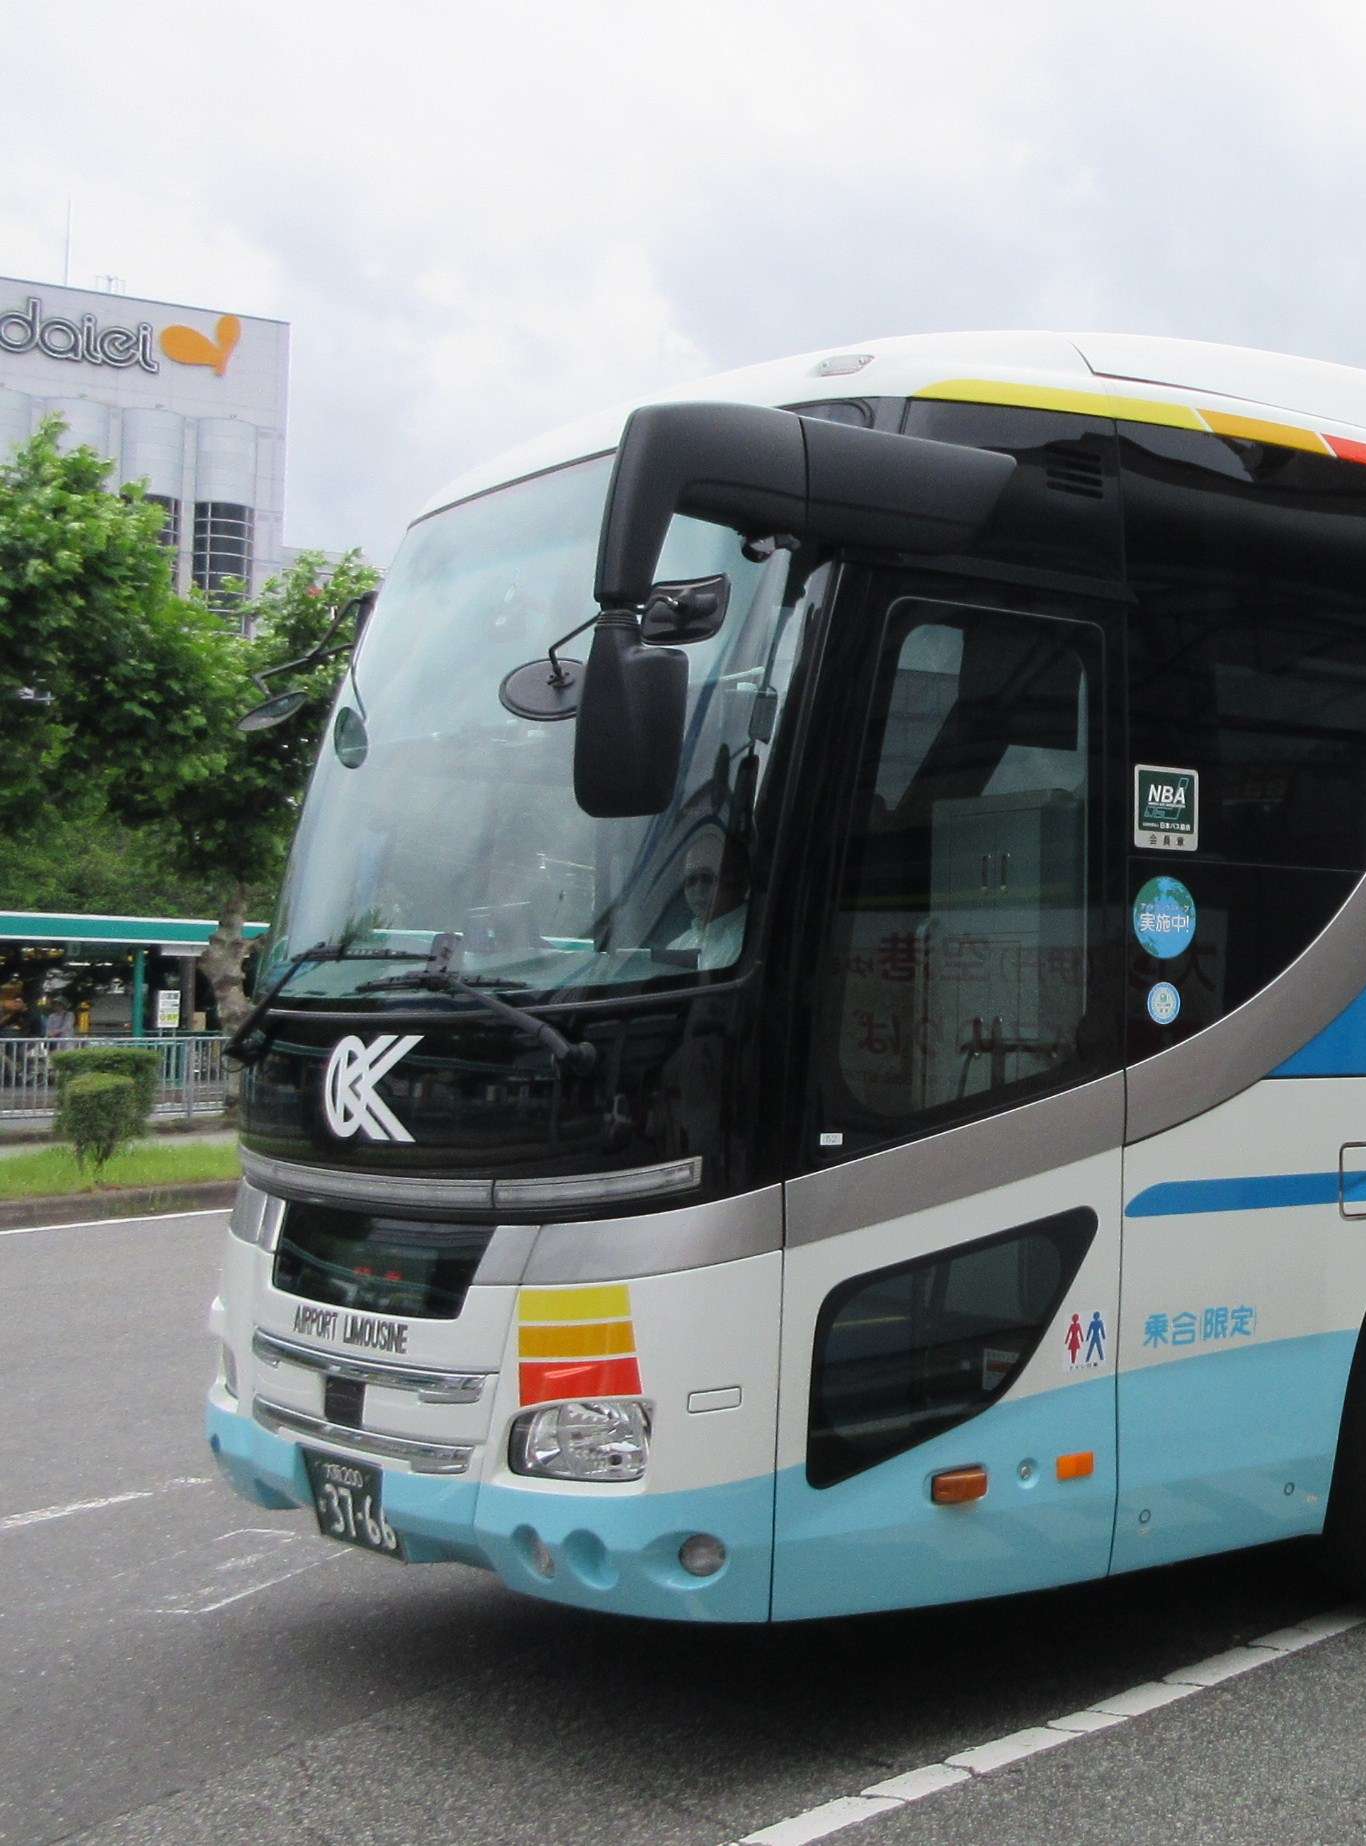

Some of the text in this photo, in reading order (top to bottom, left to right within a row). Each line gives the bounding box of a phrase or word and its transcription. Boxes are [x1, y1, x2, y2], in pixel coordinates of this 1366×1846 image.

[0, 297, 160, 374] daiei
[1148, 784, 1186, 804] NBA
[293, 1305, 408, 1354] AIRPORT LIMOUSINE
[1143, 1304, 1254, 1348] 乗合限定
